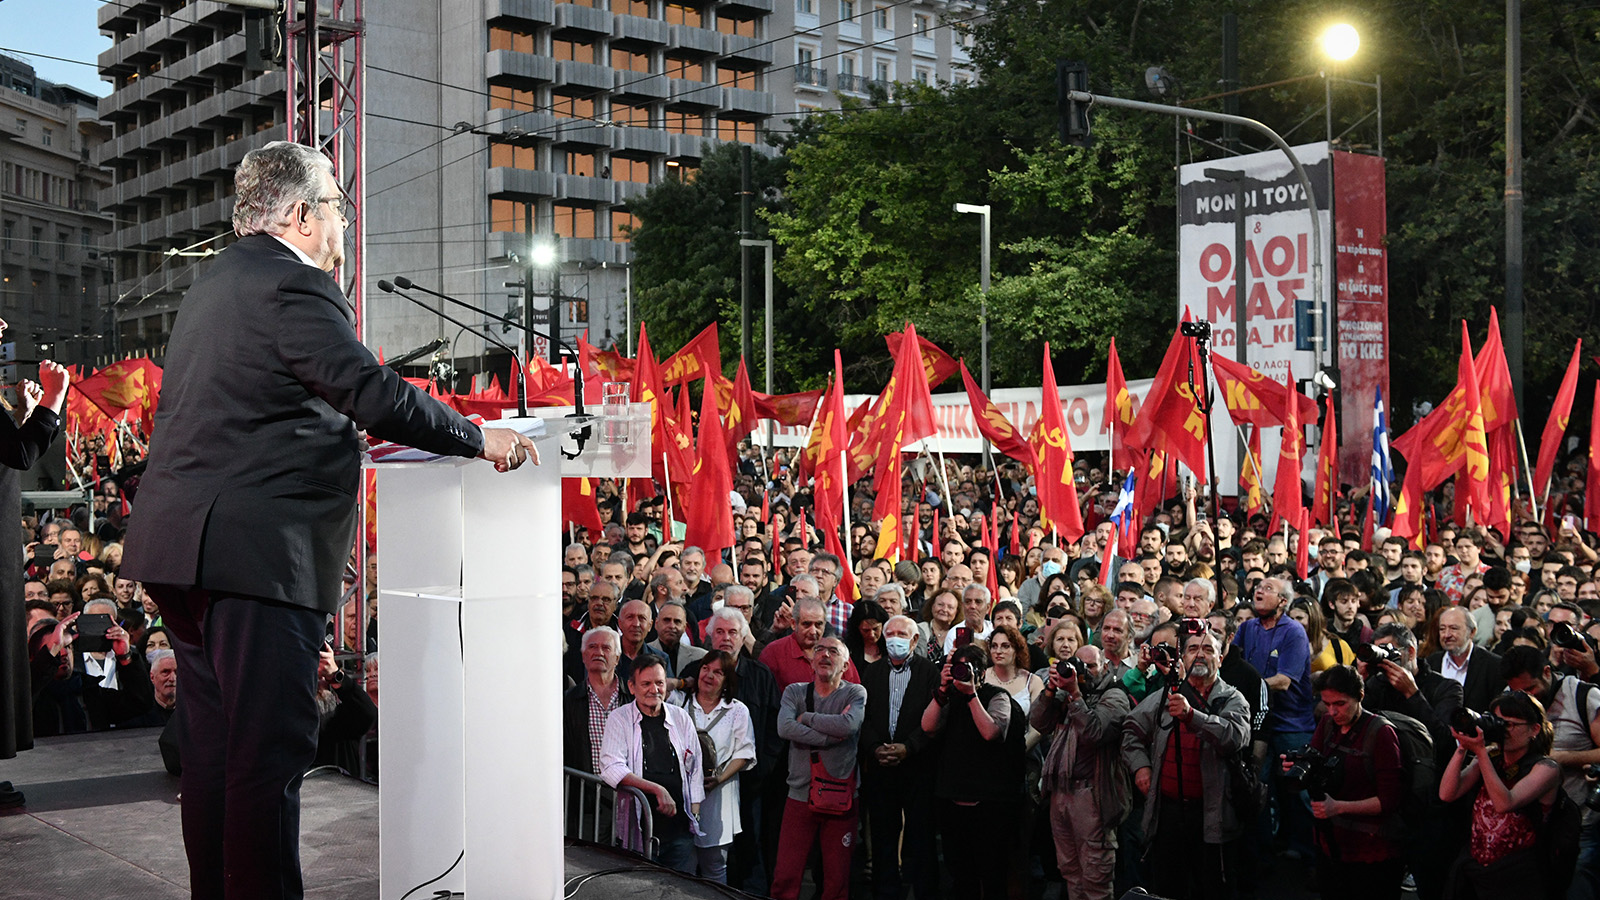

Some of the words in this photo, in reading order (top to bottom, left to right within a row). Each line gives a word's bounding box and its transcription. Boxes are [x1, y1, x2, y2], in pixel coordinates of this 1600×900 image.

[1253, 221, 1262, 234] &
[1207, 278, 1305, 324] ΜΑΣ
[1341, 342, 1358, 360] ΤΟ
[1360, 343, 1384, 360] ΚΚΕ
